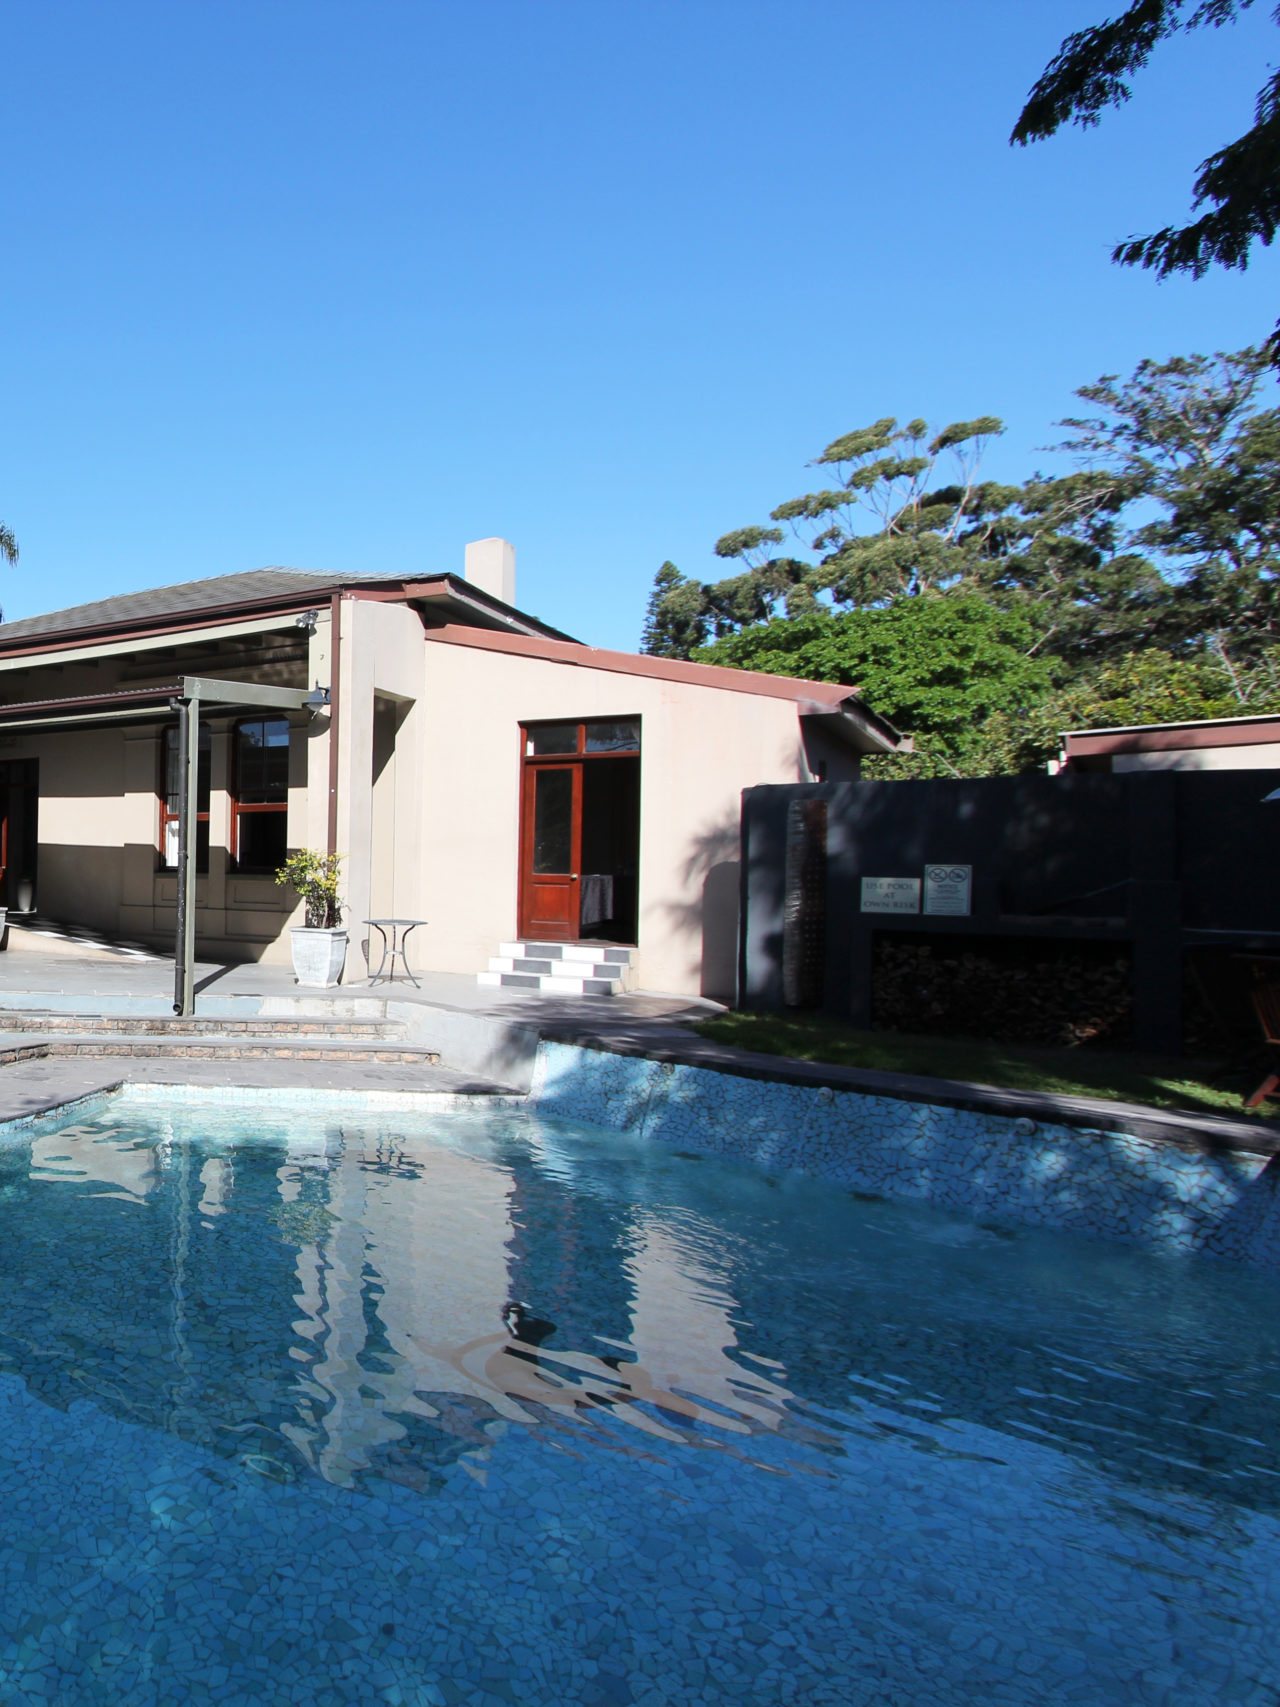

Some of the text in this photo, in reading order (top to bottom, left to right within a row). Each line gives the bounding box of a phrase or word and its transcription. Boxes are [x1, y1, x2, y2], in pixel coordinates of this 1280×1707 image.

[865, 882, 914, 890] USE POOL
[863, 901, 916, 910] OWN RISK
